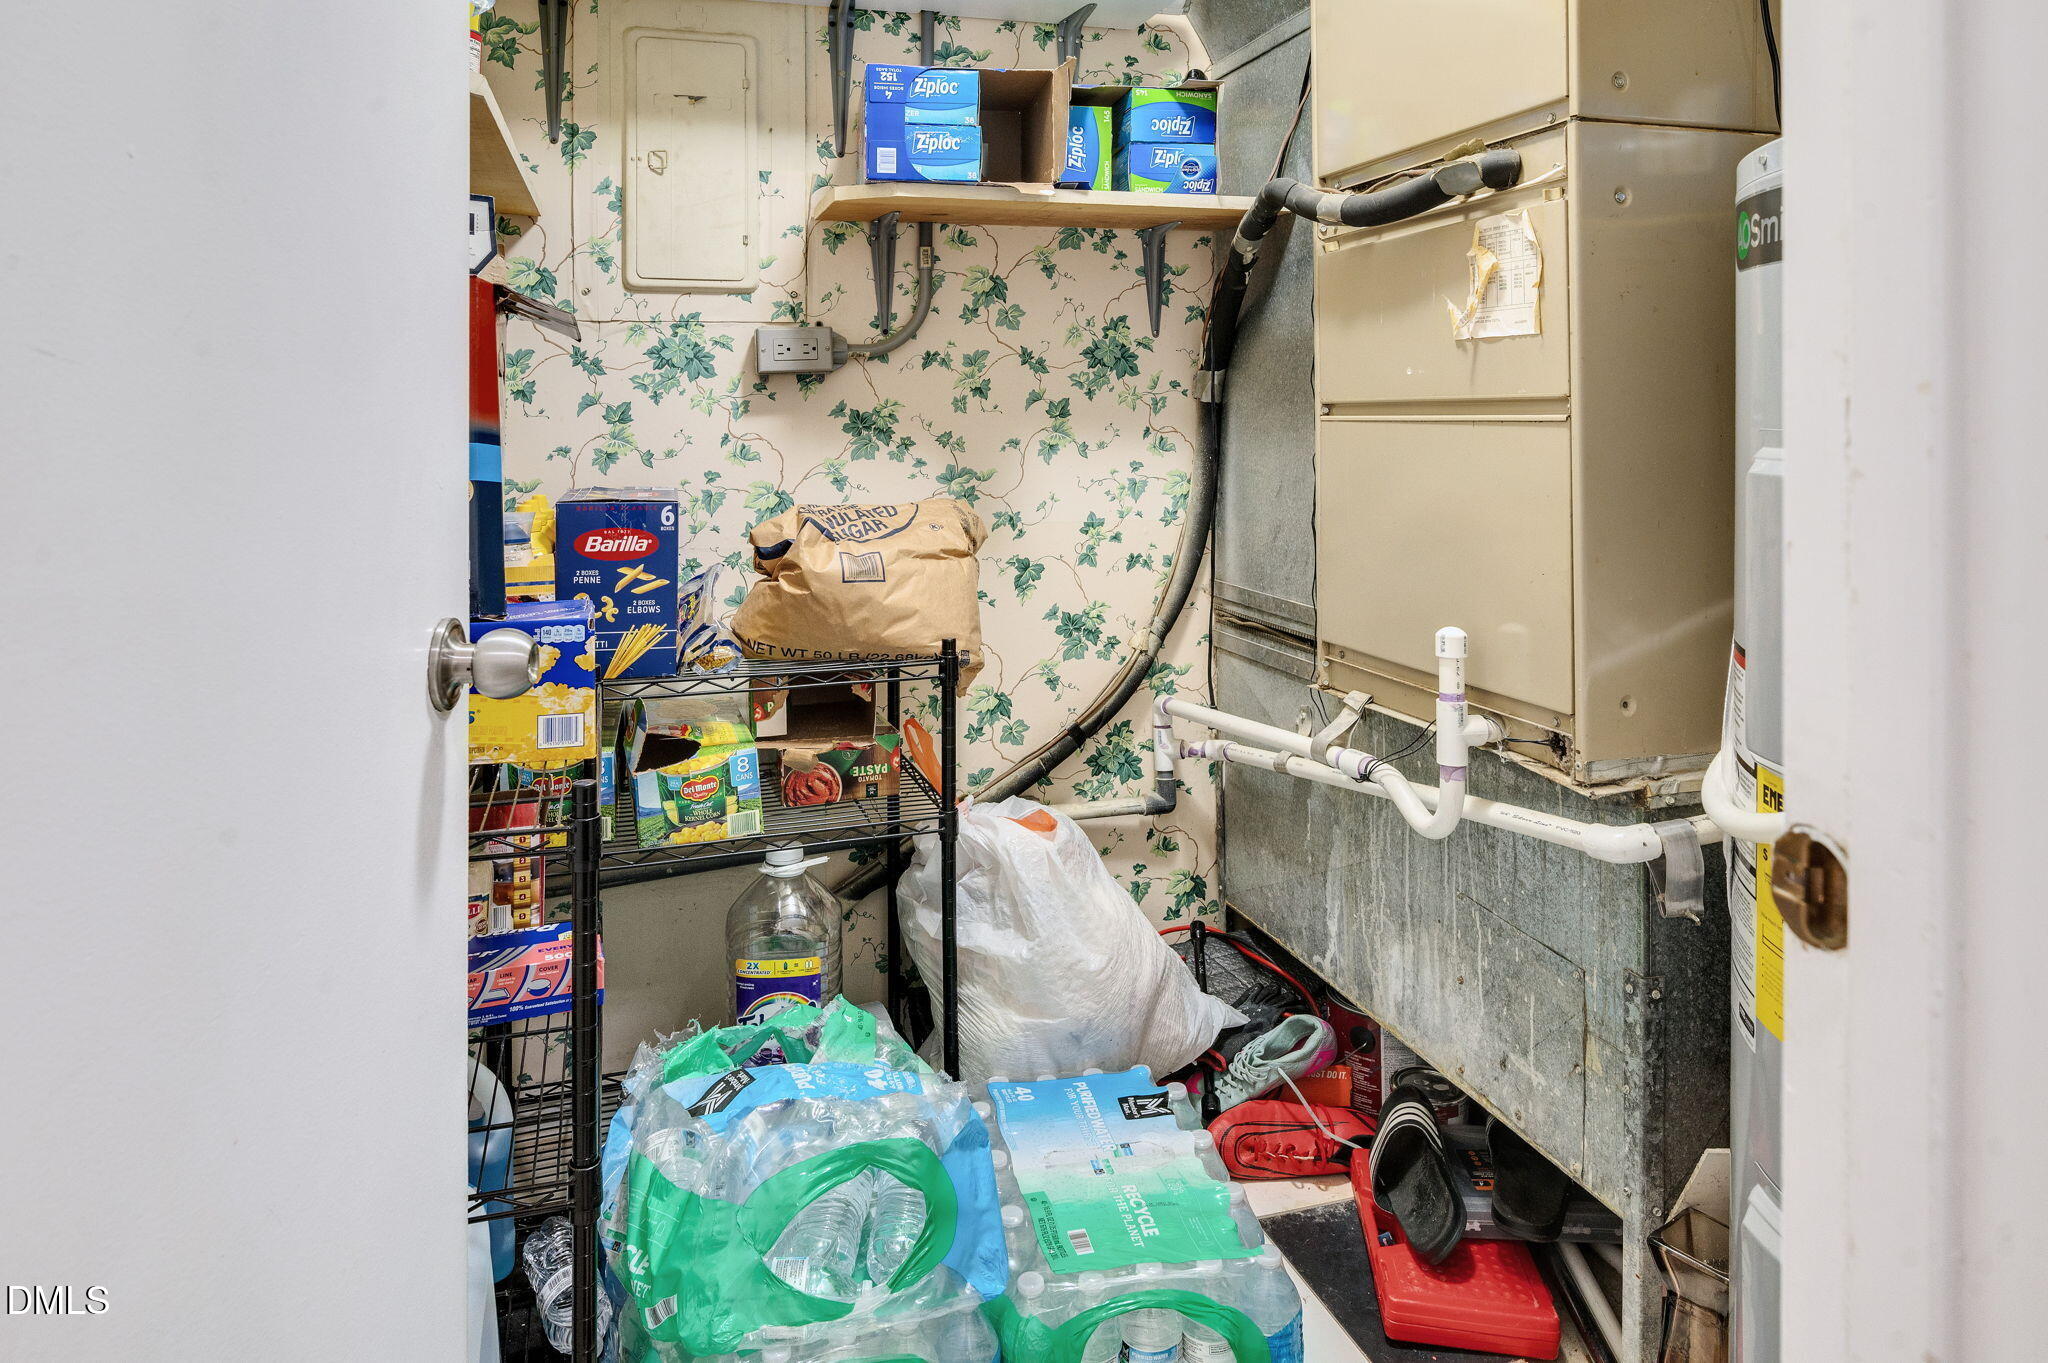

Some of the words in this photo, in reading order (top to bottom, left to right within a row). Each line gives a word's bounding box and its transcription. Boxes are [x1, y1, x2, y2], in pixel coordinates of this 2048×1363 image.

[880, 72, 898, 82] 152
[884, 91, 893, 99] 4
[914, 78, 959, 98] Ziploc
[1103, 110, 1111, 123] 145
[1151, 116, 1191, 135] Ziploc
[916, 134, 961, 154] Ziploc
[1068, 126, 1087, 168] Ziploc
[1154, 150, 1181, 168] Zipl
[1183, 178, 1212, 192] Ziploc
[661, 505, 675, 526] 6
[584, 535, 649, 553] Barilla
[573, 576, 602, 584] PENNE
[627, 606, 661, 614] ELBOWS
[743, 638, 776, 656] NET
[781, 647, 808, 658] WT
[813, 650, 832, 659] 50
[737, 756, 750, 772] 8
[852, 763, 888, 777] PASTE
[735, 772, 753, 781] CANS
[695, 781, 718, 792] Monte
[684, 814, 705, 822] KERNEL
[706, 810, 721, 819] CORN
[692, 808, 713, 816] WHOLE
[746, 962, 760, 970] 2X
[1326, 1071, 1338, 1079] DO
[1338, 1071, 1348, 1080] IT.
[1015, 1086, 1035, 1101] 40
[1064, 1088, 1075, 1100] FOR
[1071, 1099, 1084, 1120] YOUR
[1127, 1096, 1140, 1119] Member's
[1072, 1081, 1101, 1119] PURIFIED
[1091, 1115, 1117, 1151] WATER
[1113, 1193, 1130, 1213] THE
[1121, 1185, 1160, 1238] RECYCLE
[1121, 1210, 1145, 1249] PLANET
[1153, 1352, 1169, 1361] WATER
